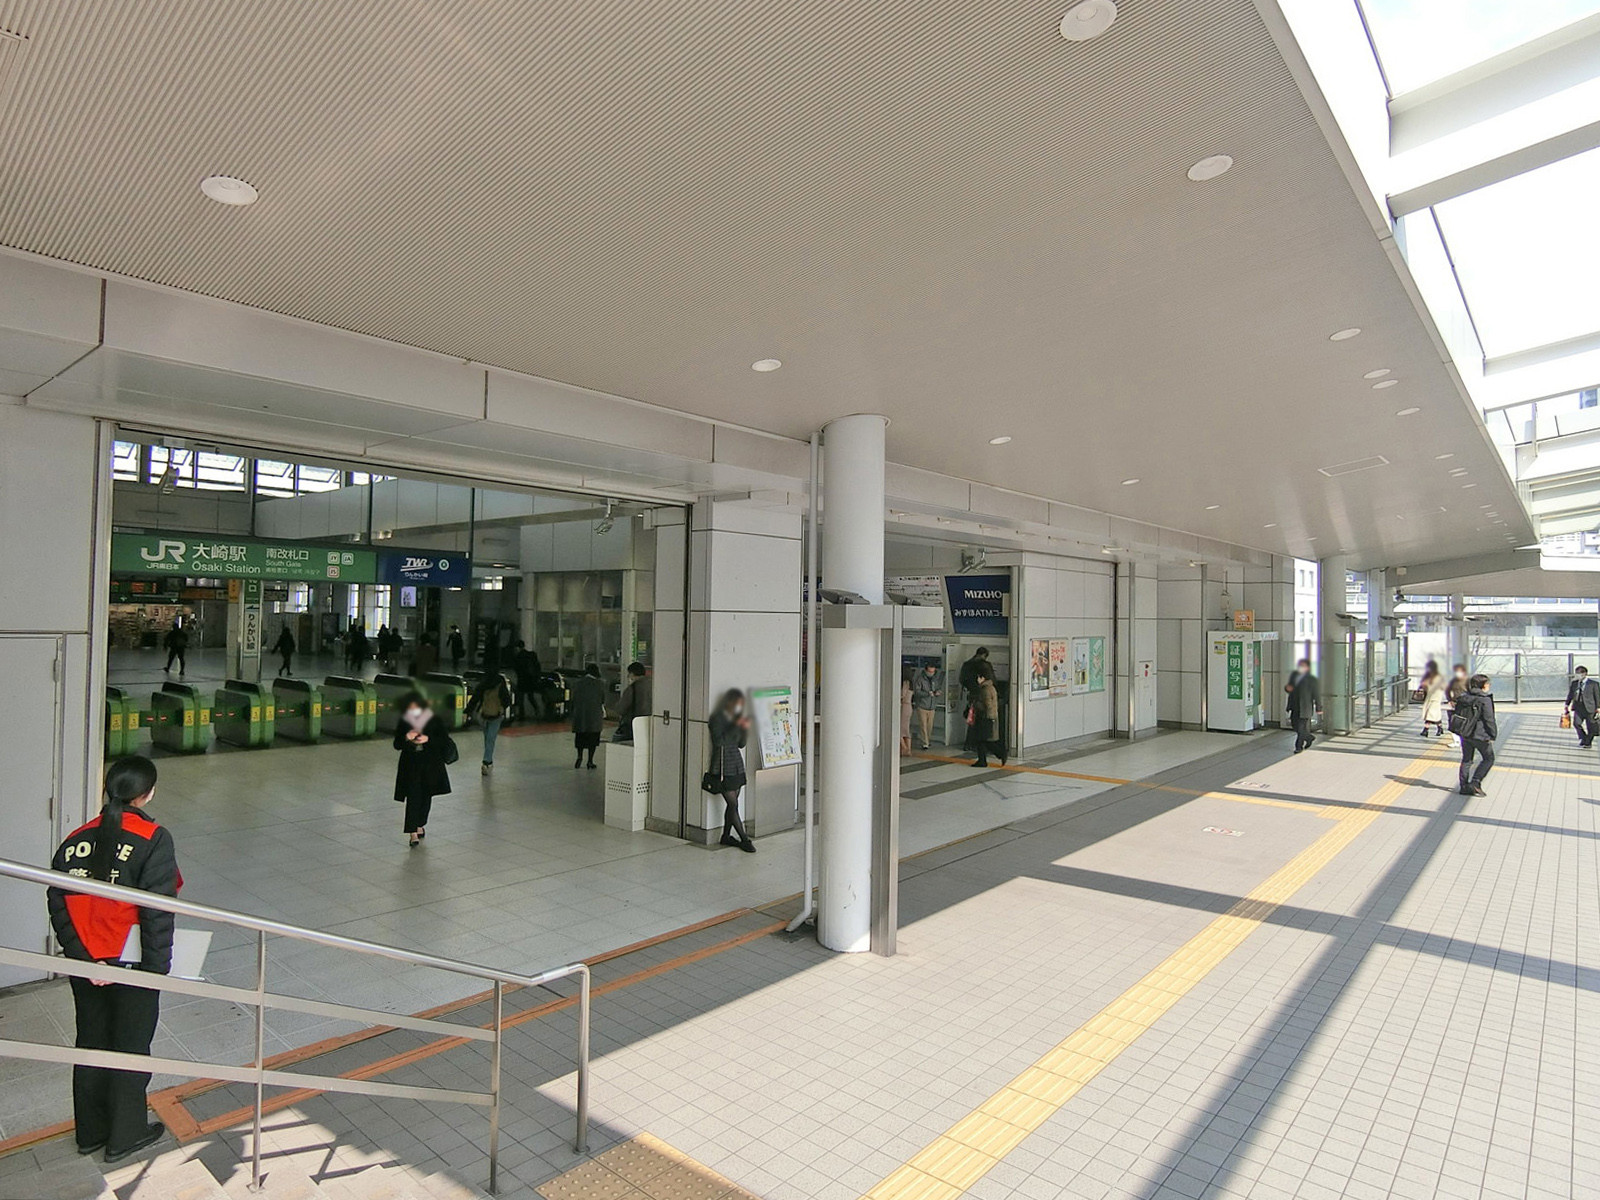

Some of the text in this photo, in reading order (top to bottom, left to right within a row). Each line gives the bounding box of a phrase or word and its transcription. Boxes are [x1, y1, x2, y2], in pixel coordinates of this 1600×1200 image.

[141, 540, 186, 563] JR
[192, 543, 247, 562] 大崎駅
[266, 548, 309, 560] 南改札口
[225, 563, 261, 574] Station
[265, 560, 285, 568] South
[405, 557, 428, 567] TWR
[964, 590, 1003, 599] MIZUHO
[247, 614, 256, 650] りんかい線
[1229, 645, 1241, 695] 証明写真
[65, 841, 134, 863] POE
